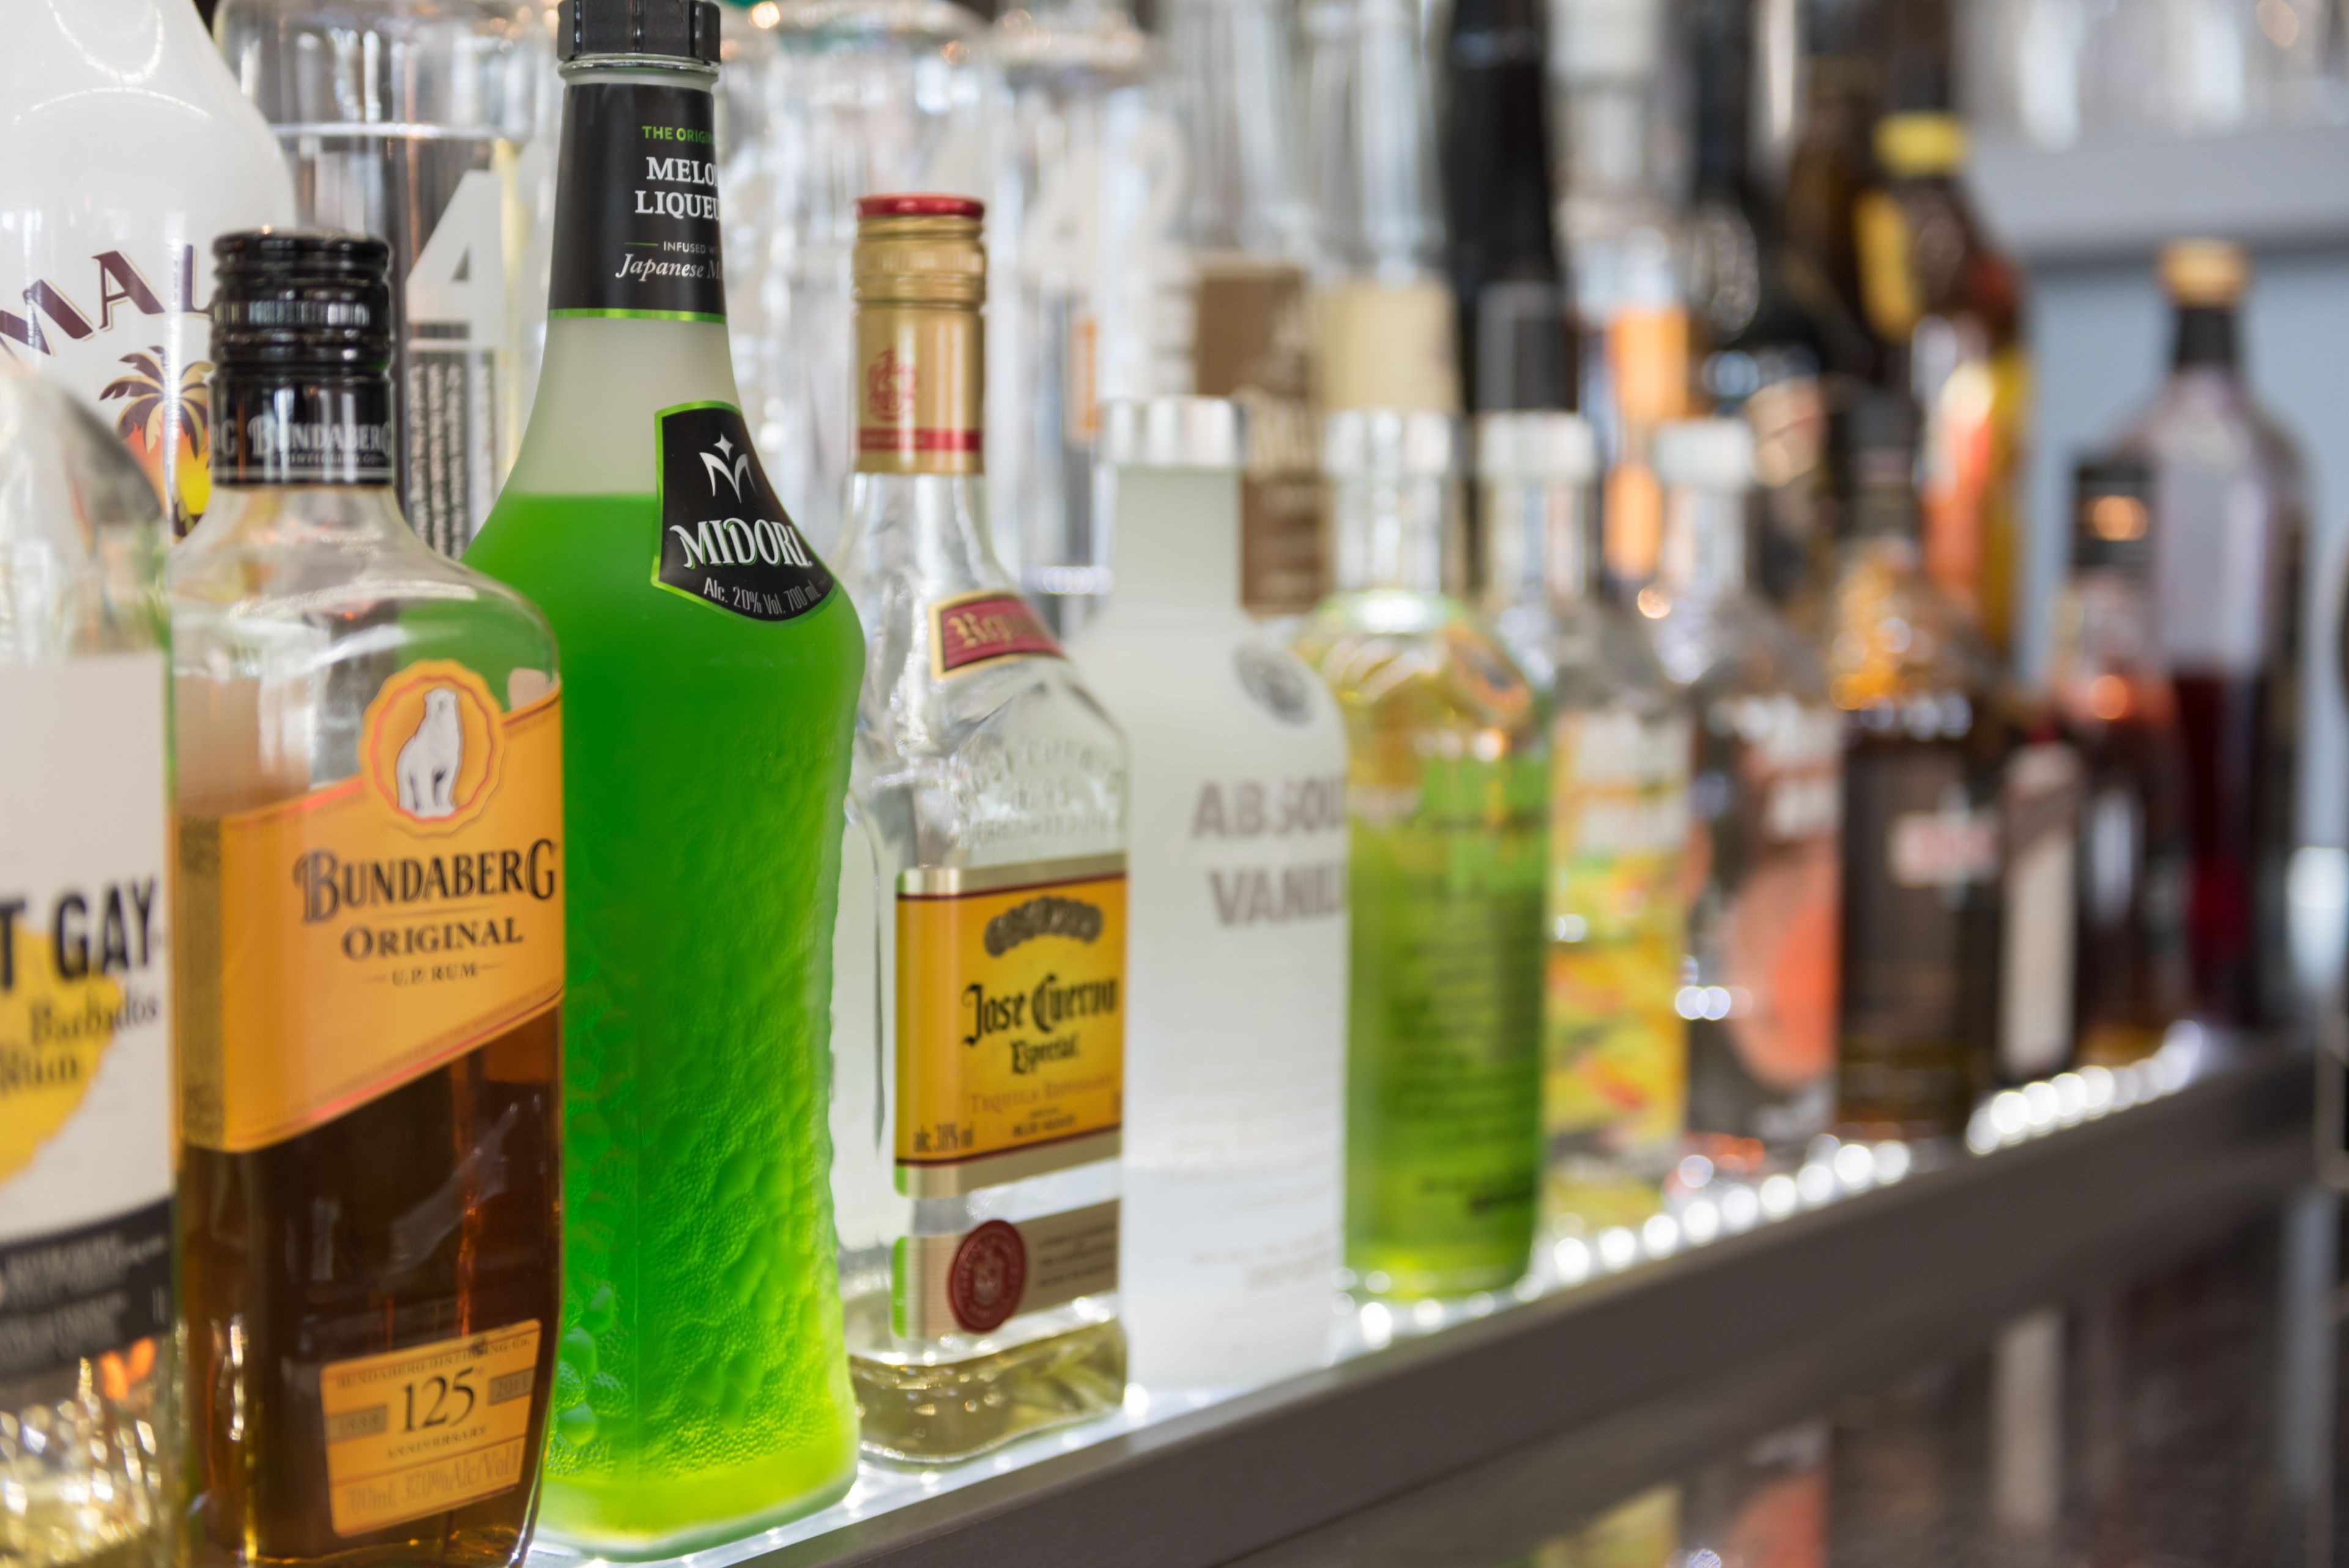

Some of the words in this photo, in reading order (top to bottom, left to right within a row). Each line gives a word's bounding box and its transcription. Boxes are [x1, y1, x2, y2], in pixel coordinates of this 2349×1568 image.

[642, 125, 672, 140] THE
[616, 253, 703, 281] Japanese
[664, 241, 706, 255] INFUSED
[669, 518, 811, 570] MIDORI
[703, 577, 728, 603] Alc.
[733, 586, 762, 614] 20%
[763, 593, 785, 615] Vol.
[784, 585, 807, 612] 700
[292, 838, 557, 923] BUNDABERG
[51, 875, 154, 980] GAY
[340, 916, 524, 962] ORIGINAL
[431, 961, 477, 981] RUM
[401, 1367, 476, 1435] 125
